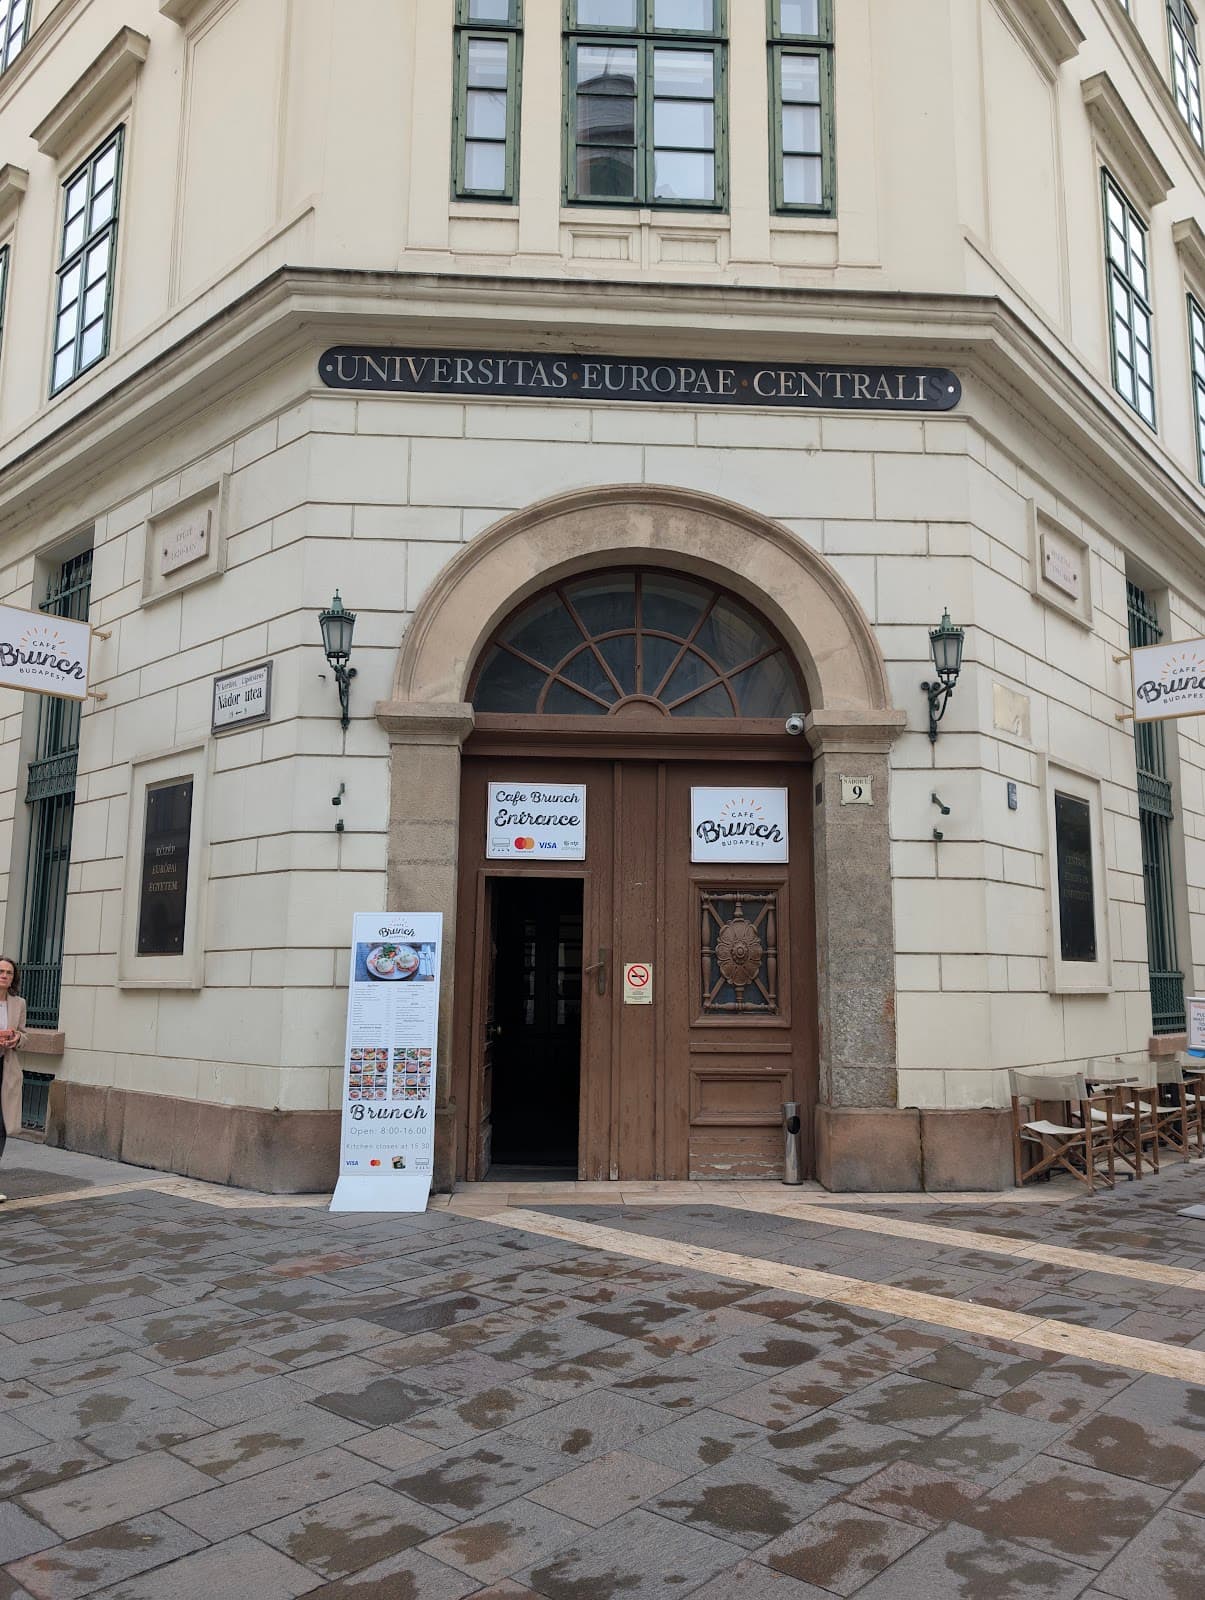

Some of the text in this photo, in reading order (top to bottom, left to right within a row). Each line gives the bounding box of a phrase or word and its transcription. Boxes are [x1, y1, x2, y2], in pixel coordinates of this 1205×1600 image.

[334, 354, 944, 401] UNIVERSITAS EUROPAE CENTRALIS
[0, 642, 86, 680] Brunch
[19, 667, 66, 681] BUDAPEST
[1172, 666, 1197, 675] CAFE
[1163, 693, 1204, 704] BUDAPES
[495, 790, 580, 806] Cafe Brunch
[852, 785, 863, 800] 9
[494, 808, 580, 827] Entrance
[696, 820, 784, 844] Brunch
[378, 927, 416, 937] Brunch
[350, 1104, 428, 1121] Brunch
[350, 1127, 377, 1136] Open:
